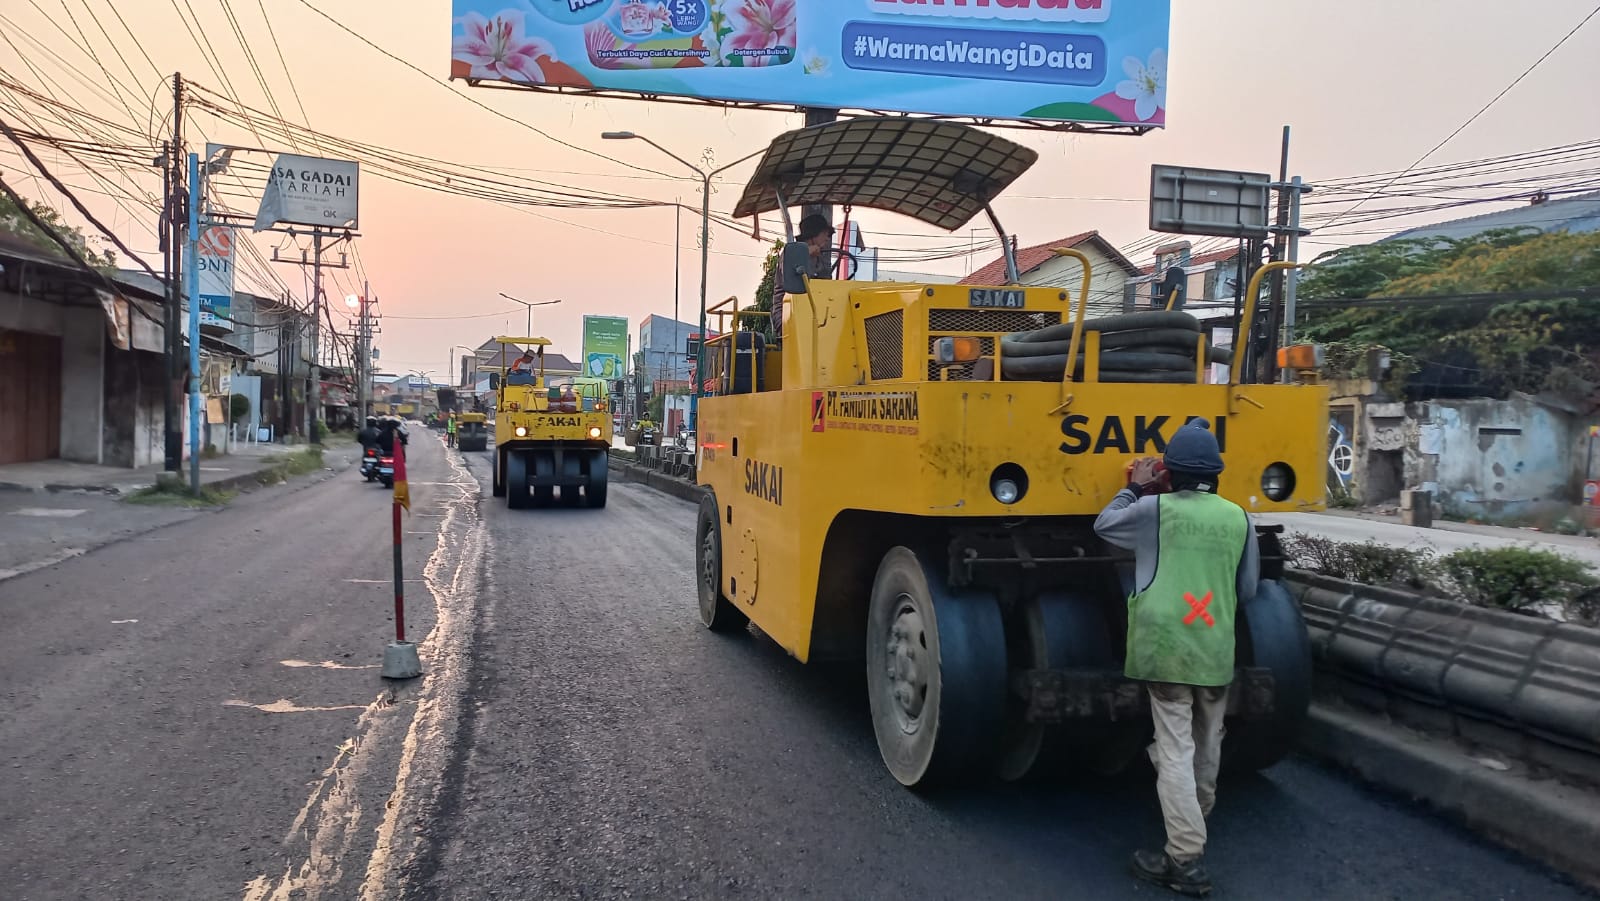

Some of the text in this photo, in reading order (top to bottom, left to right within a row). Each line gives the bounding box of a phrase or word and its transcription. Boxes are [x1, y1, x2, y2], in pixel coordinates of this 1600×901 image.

[598, 50, 629, 58] Terbukti
[629, 50, 648, 59] Daya
[649, 50, 666, 58] Cuci
[734, 48, 788, 58] Detergen Bubuk
[854, 36, 1093, 71] #WarnaWangiDaia
[300, 170, 351, 186] GADAI
[323, 209, 337, 219] OK
[199, 257, 228, 273] BNI
[971, 290, 1024, 307] SAKAI
[879, 391, 919, 420] SARANA
[1059, 414, 1226, 455] SAKI
[745, 457, 783, 507] SAKAI
